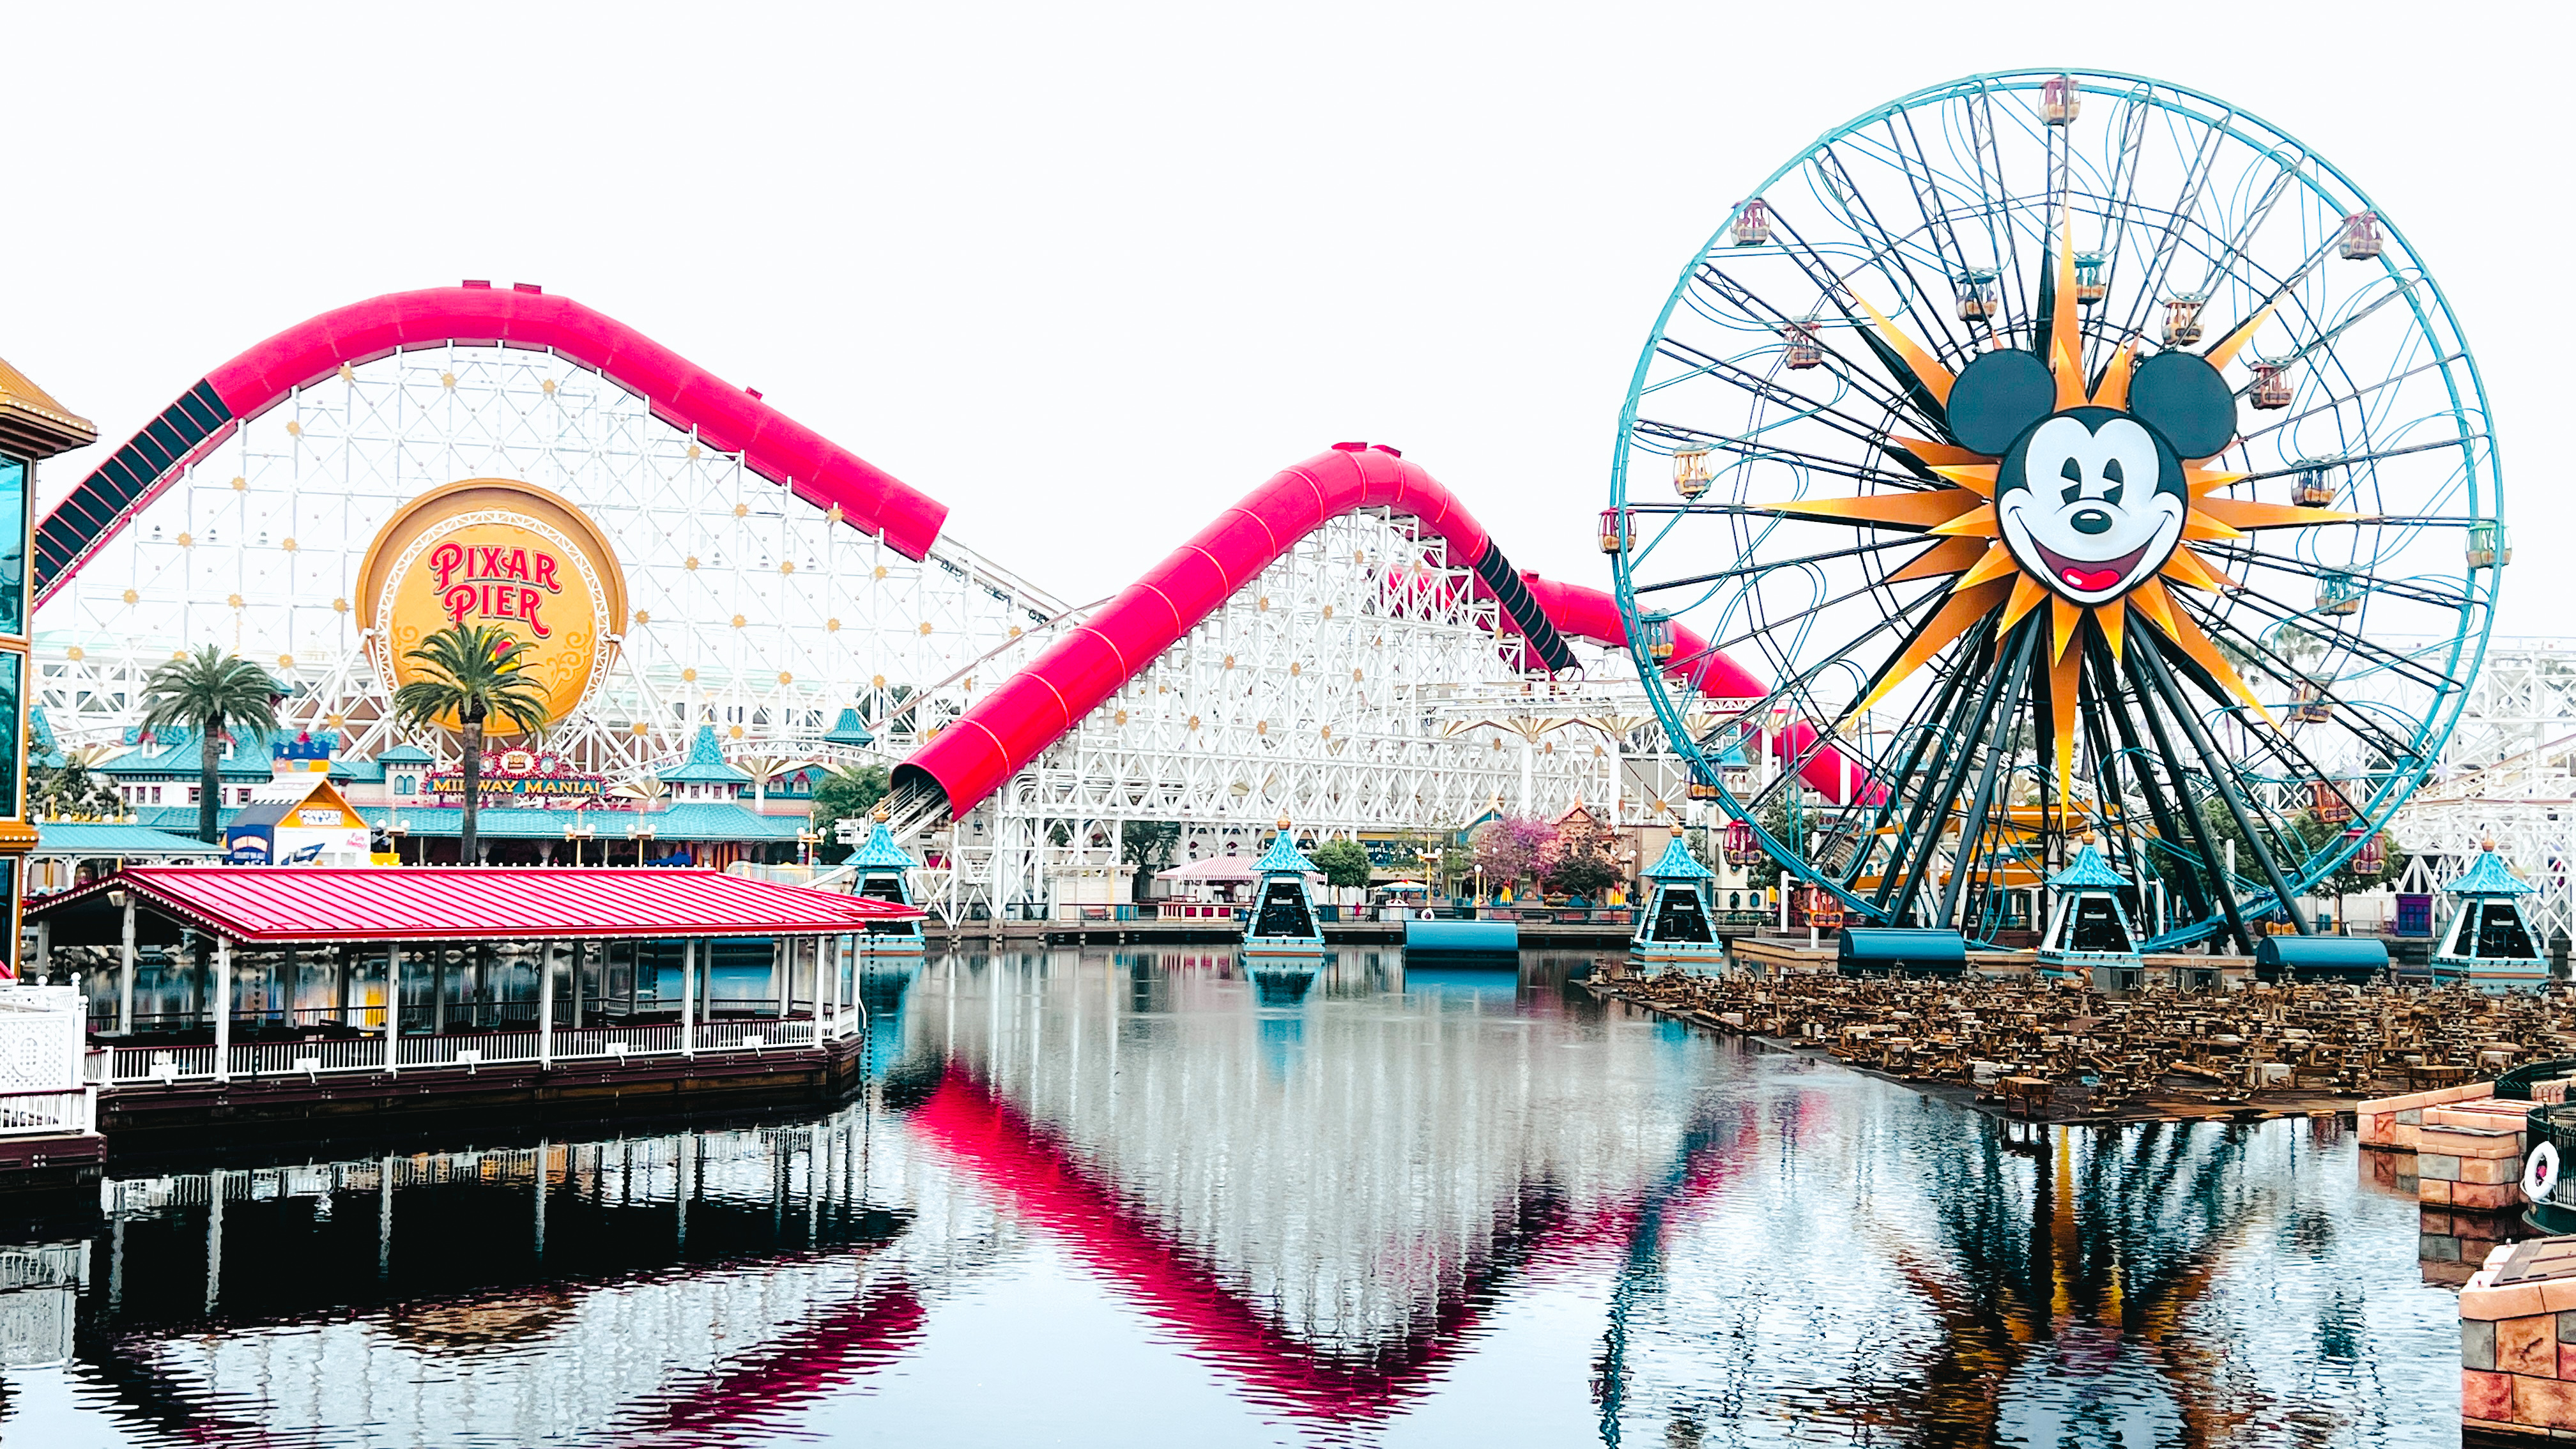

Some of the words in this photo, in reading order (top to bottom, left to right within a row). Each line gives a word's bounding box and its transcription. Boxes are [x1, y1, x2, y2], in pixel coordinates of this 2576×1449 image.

[429, 542, 562, 594] PIXAR
[442, 582, 552, 639] PIER
[507, 755, 528, 763] TOY
[525, 779, 601, 794] MANIA!
